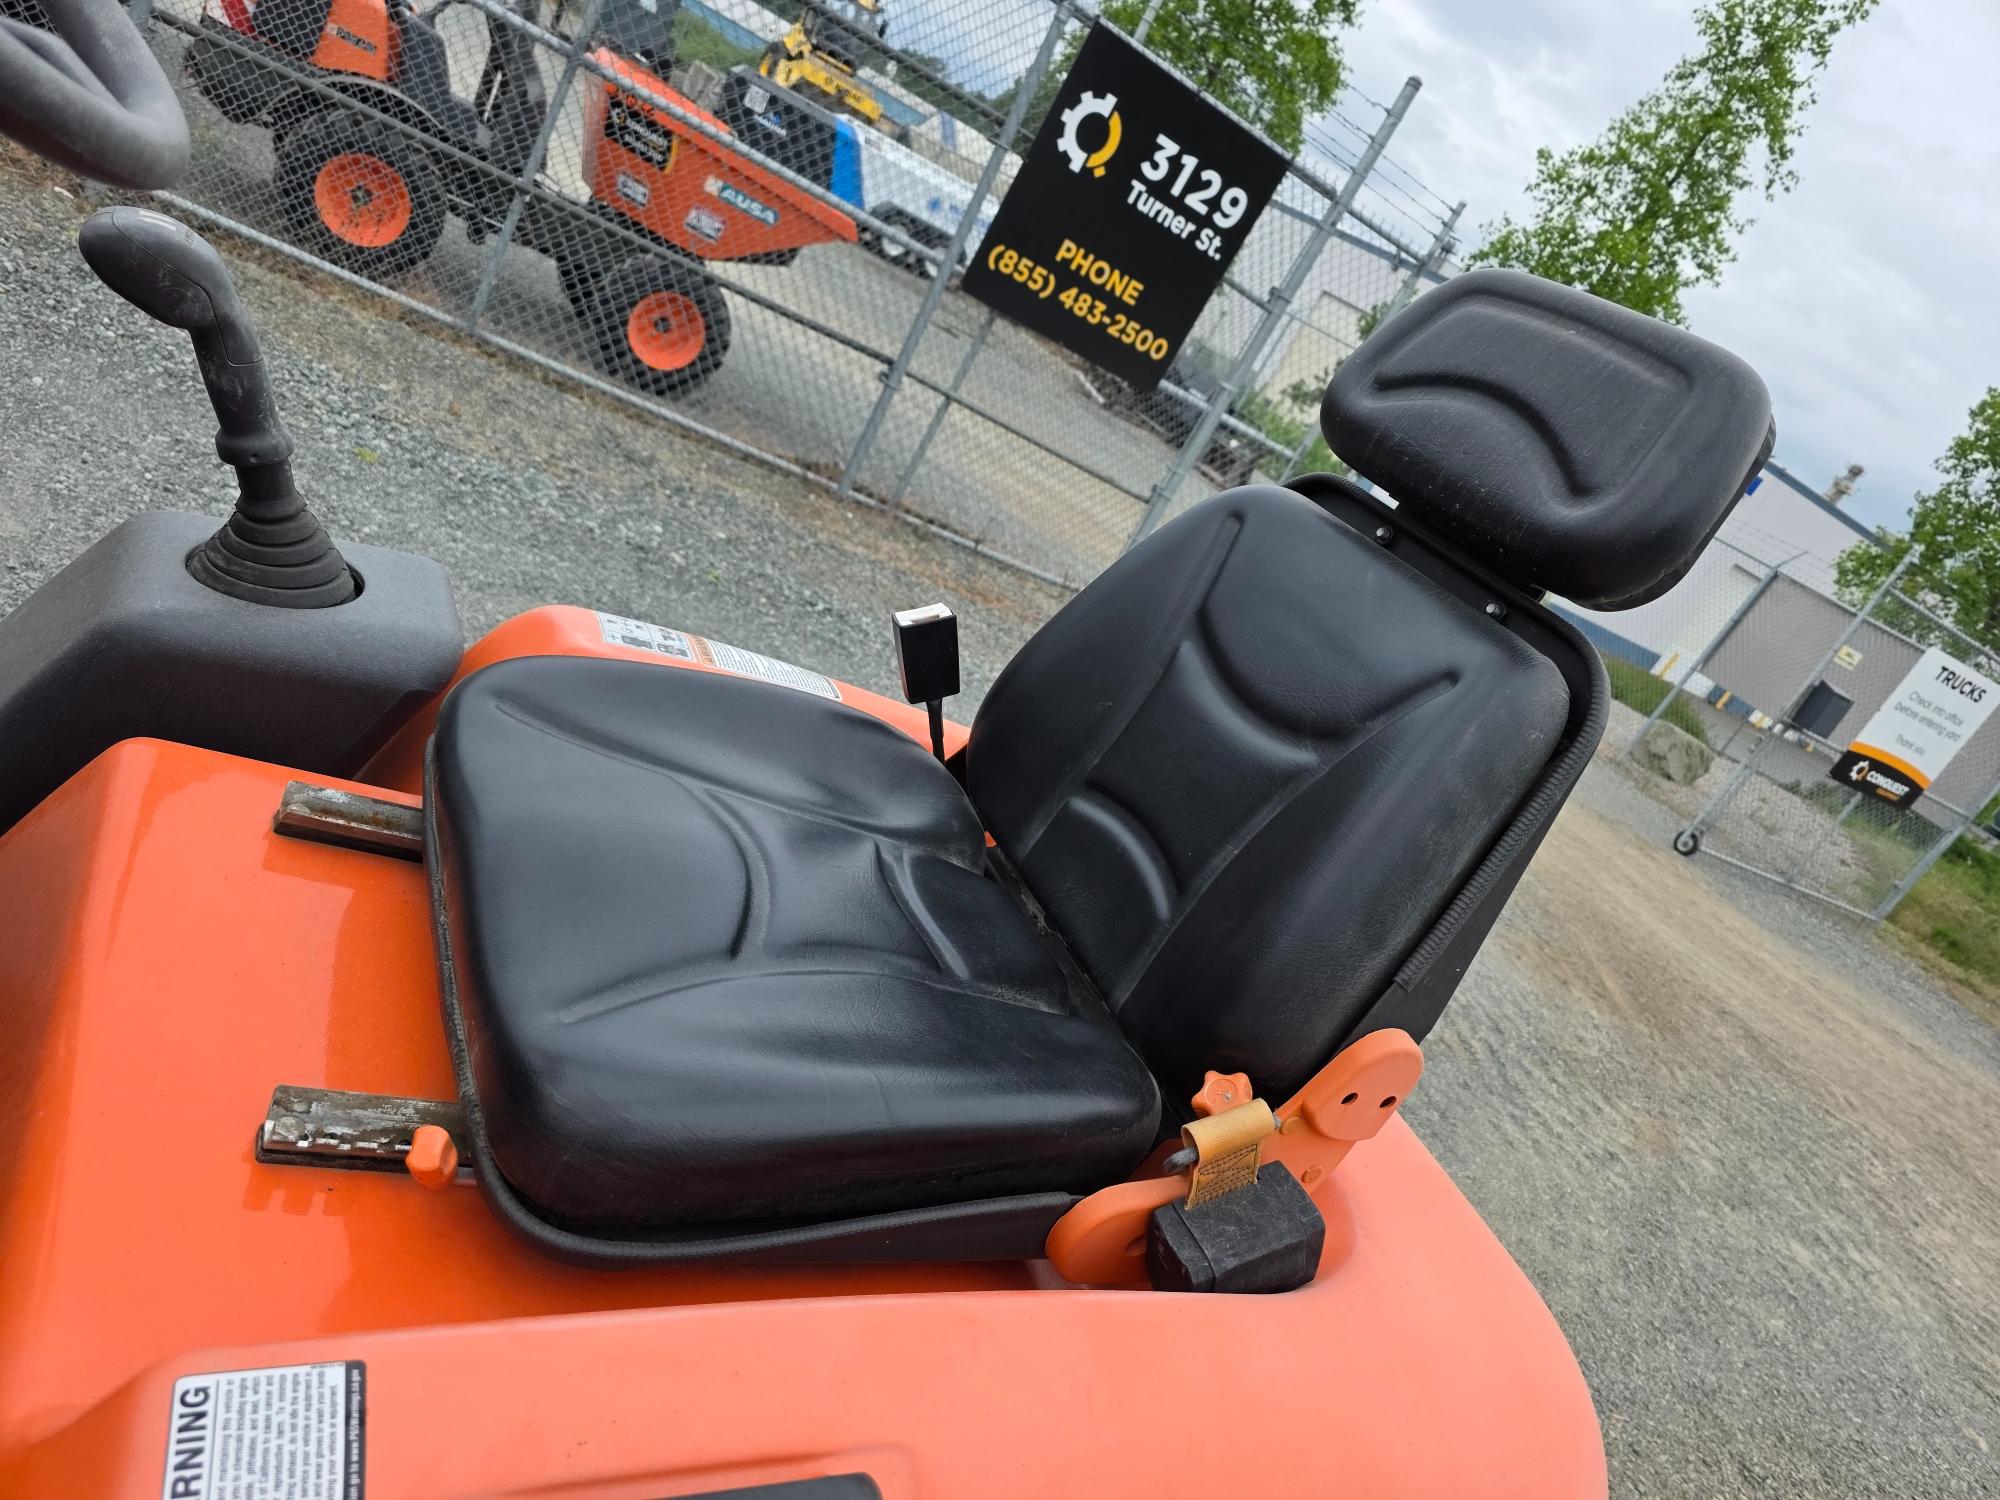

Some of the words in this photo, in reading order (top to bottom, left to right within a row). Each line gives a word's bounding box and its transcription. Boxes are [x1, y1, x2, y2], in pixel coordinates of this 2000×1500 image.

[719, 185, 776, 225] AUSA
[1127, 179, 1196, 242] Turner
[1195, 228, 1221, 261] St.
[1140, 133, 1248, 230] 3129
[987, 245, 1056, 298] (855)
[1058, 284, 1168, 360] 483-2500
[1056, 239, 1145, 306] PHONE
[1935, 665, 1987, 703] TRUCKS
[171, 1386, 211, 1500] RNING
